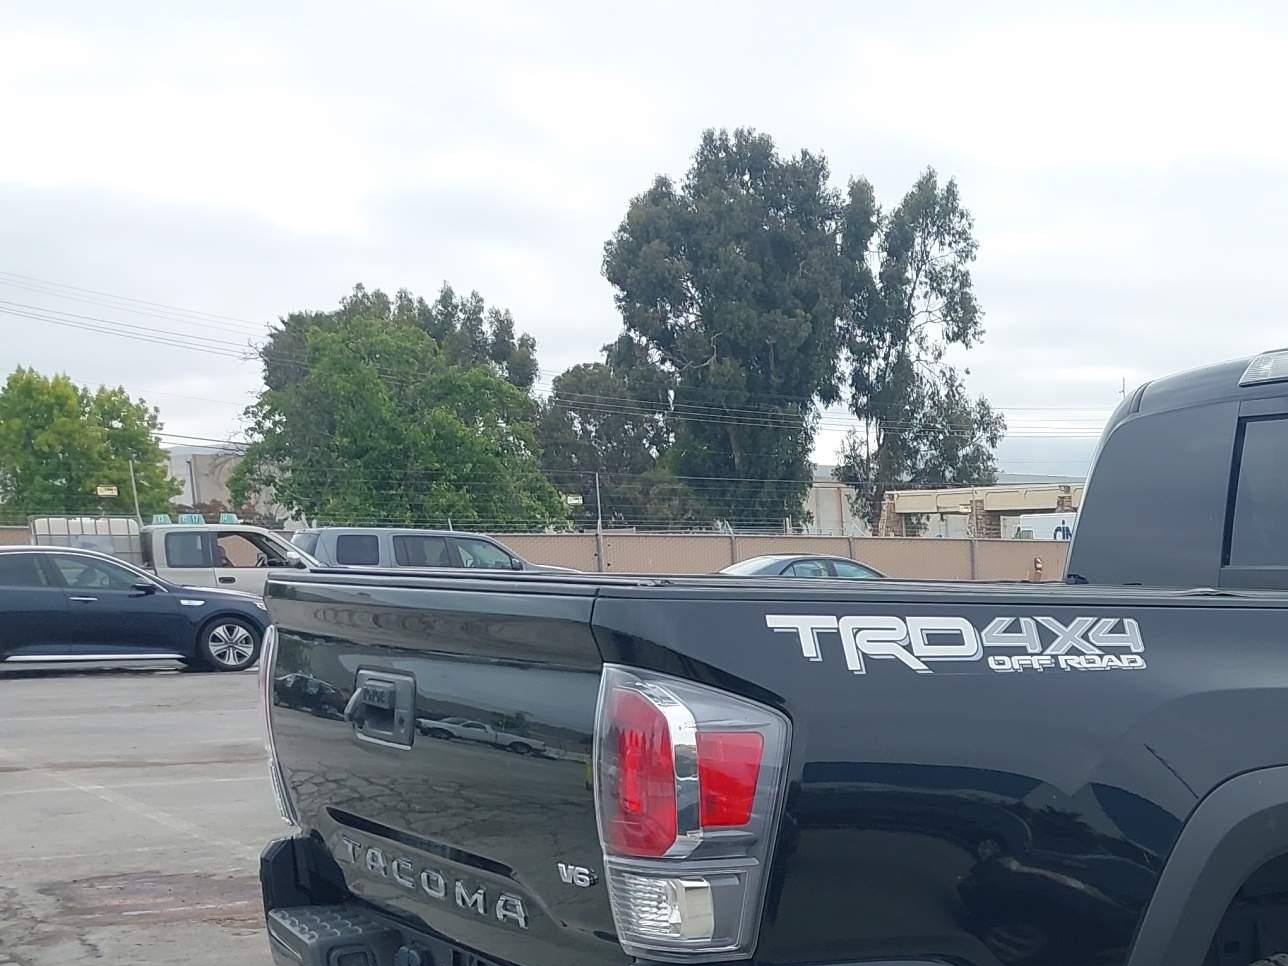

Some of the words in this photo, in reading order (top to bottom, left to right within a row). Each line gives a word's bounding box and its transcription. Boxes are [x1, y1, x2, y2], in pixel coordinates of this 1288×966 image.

[765, 614, 983, 674] TRD
[981, 616, 1146, 655] 4X4
[987, 655, 1055, 673] OFF
[1058, 655, 1147, 671] ROAD
[342, 834, 529, 930] TACOMA
[557, 862, 598, 888] V6
